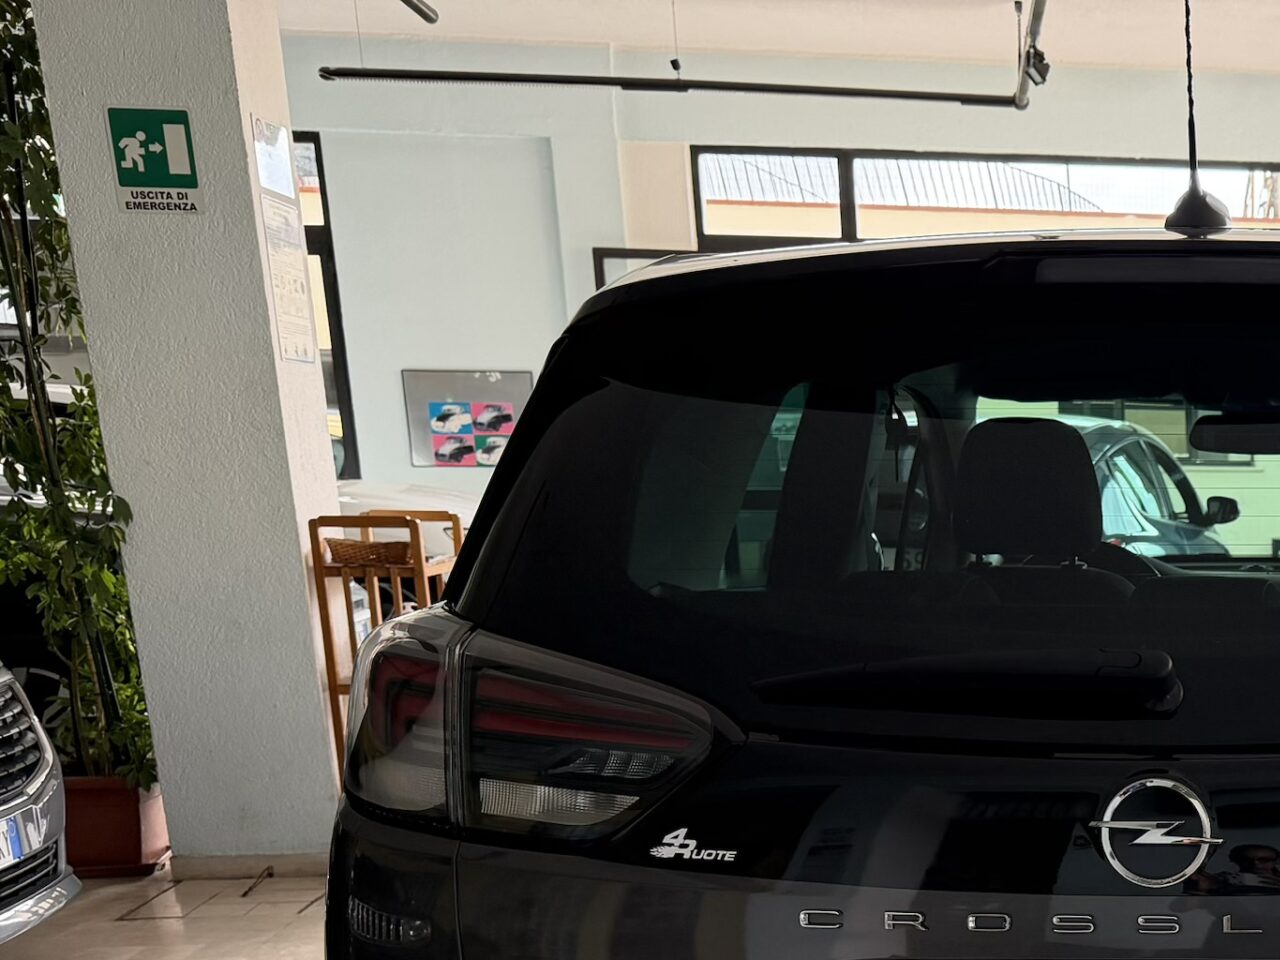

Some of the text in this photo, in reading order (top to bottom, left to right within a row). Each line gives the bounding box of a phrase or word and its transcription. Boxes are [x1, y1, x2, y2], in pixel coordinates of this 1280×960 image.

[130, 191, 188, 200] USCITA DI
[125, 201, 198, 211] EMERGENZA
